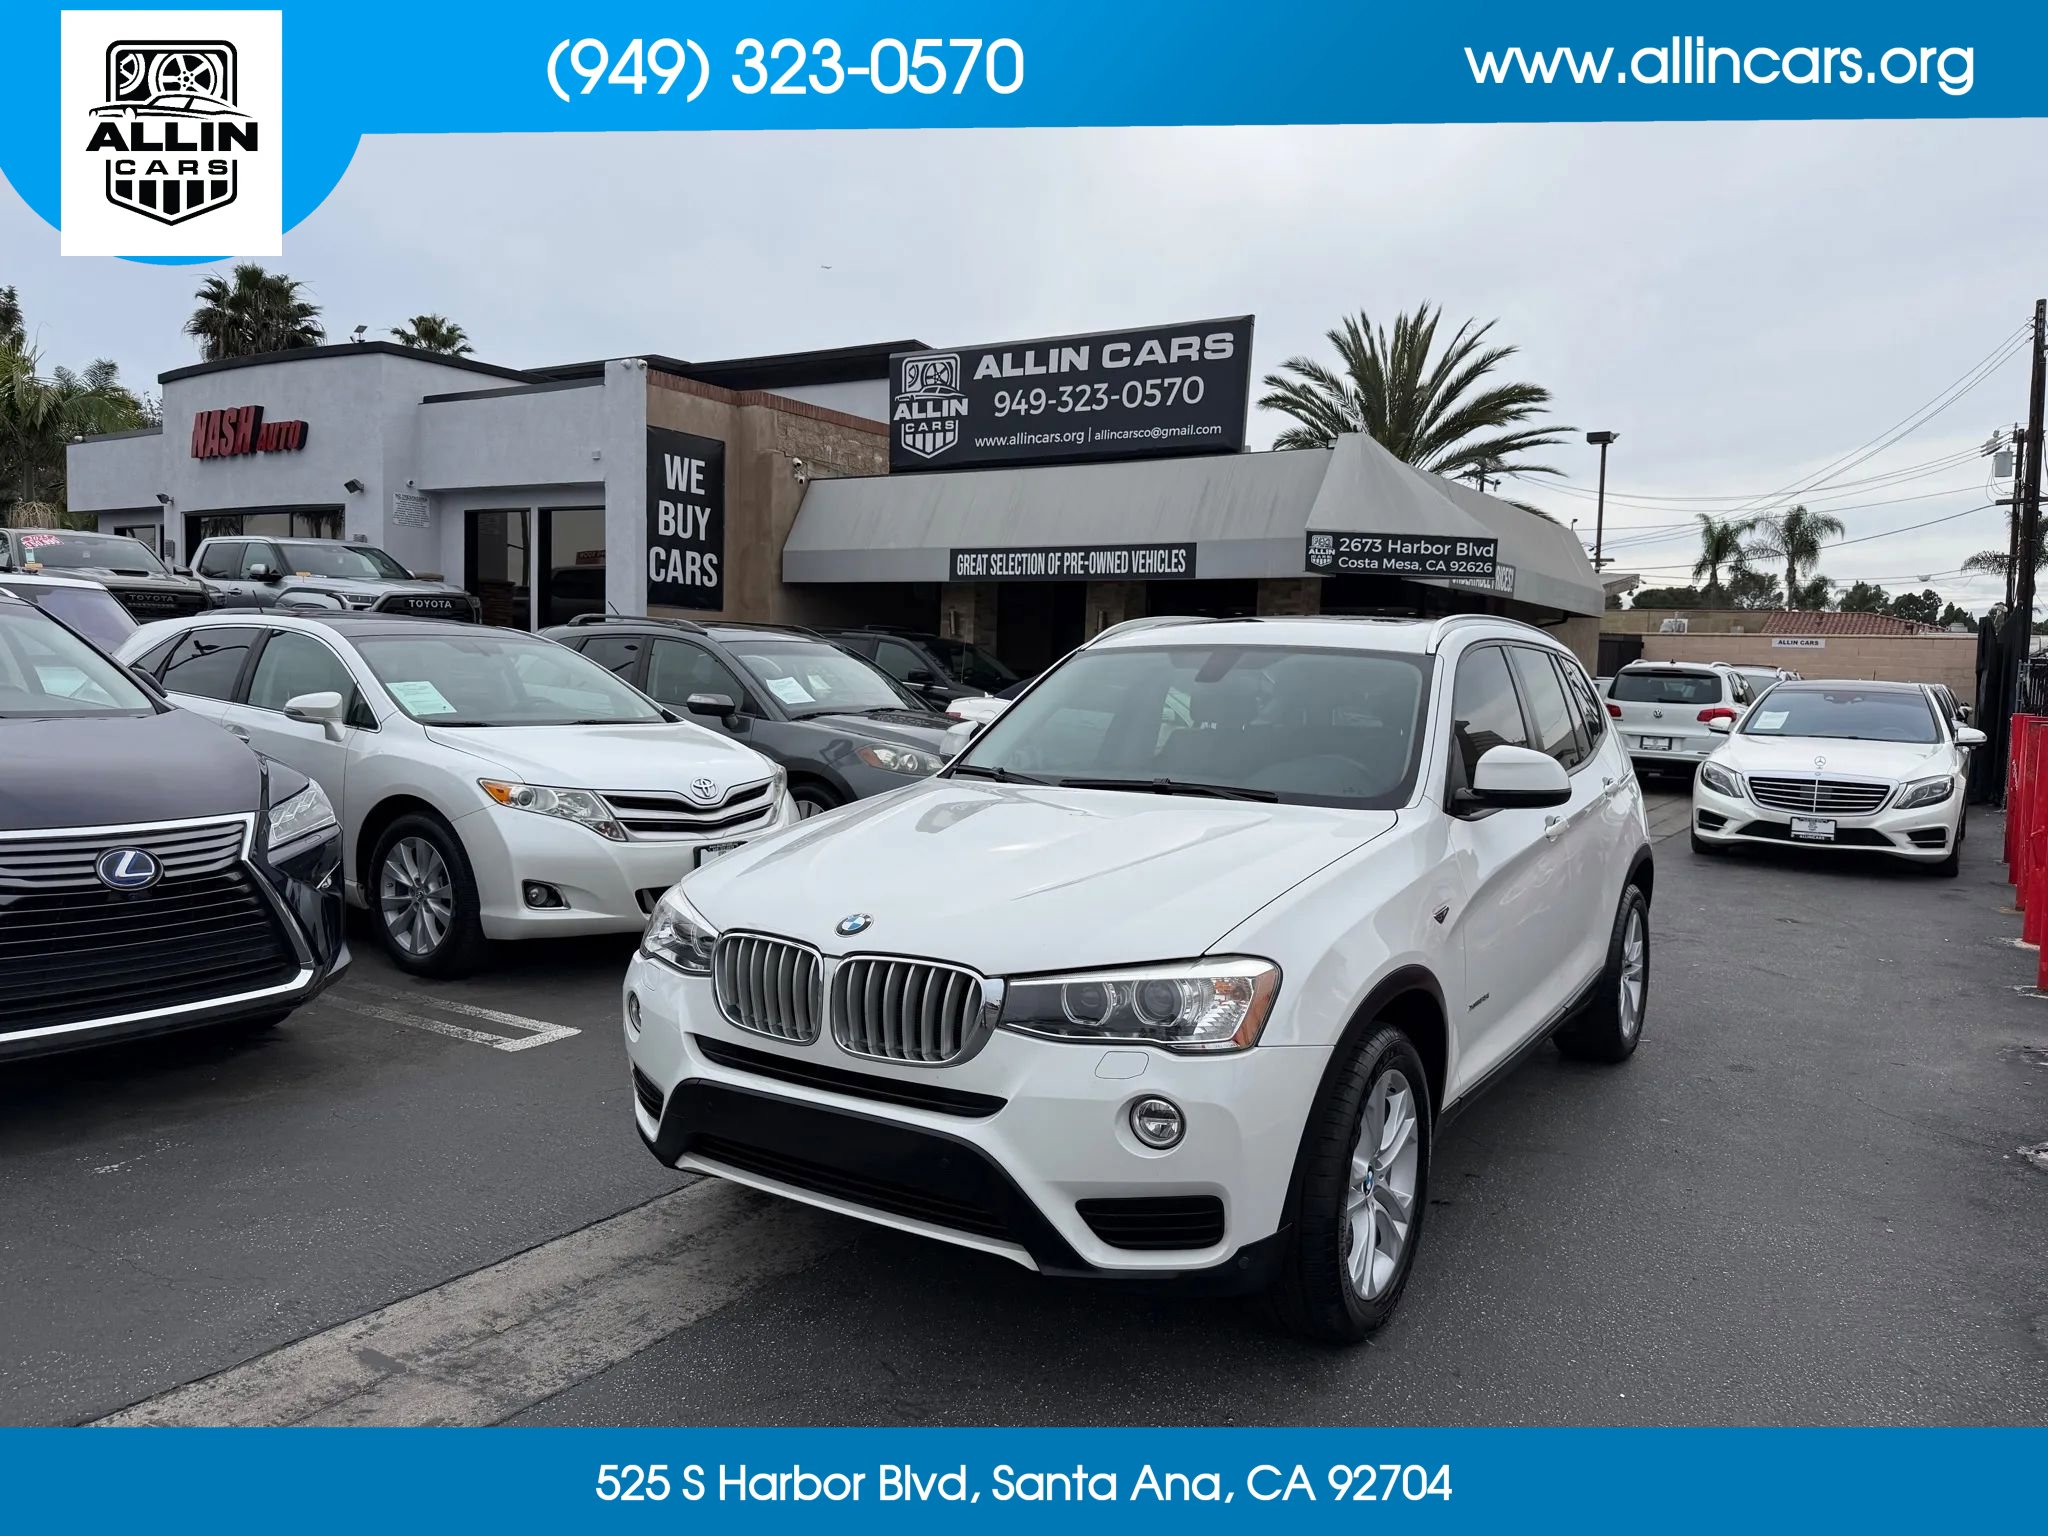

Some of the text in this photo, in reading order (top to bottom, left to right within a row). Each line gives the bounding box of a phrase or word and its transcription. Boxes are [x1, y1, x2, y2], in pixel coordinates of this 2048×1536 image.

[973, 332, 1234, 381] ALLIN CARS
[993, 375, 1205, 418] 949-323-0570
[191, 405, 260, 459] NASH
[893, 398, 969, 433] ALLIN CARS
[975, 424, 1222, 448] www.allincars.org allincarsco@gmail.com
[664, 453, 706, 495] WE
[658, 499, 711, 541] BUY
[956, 548, 1187, 576] GREAT SELECTION OF PRE-OWNED VEHICLES
[1338, 556, 1493, 573] Costa Mesa, CA 92626
[1339, 537, 1495, 558] 2673 Harbor Blvd
[649, 546, 718, 588] CARS
[129, 594, 174, 602] TOYOTA
[408, 599, 452, 609] TOYOTA
